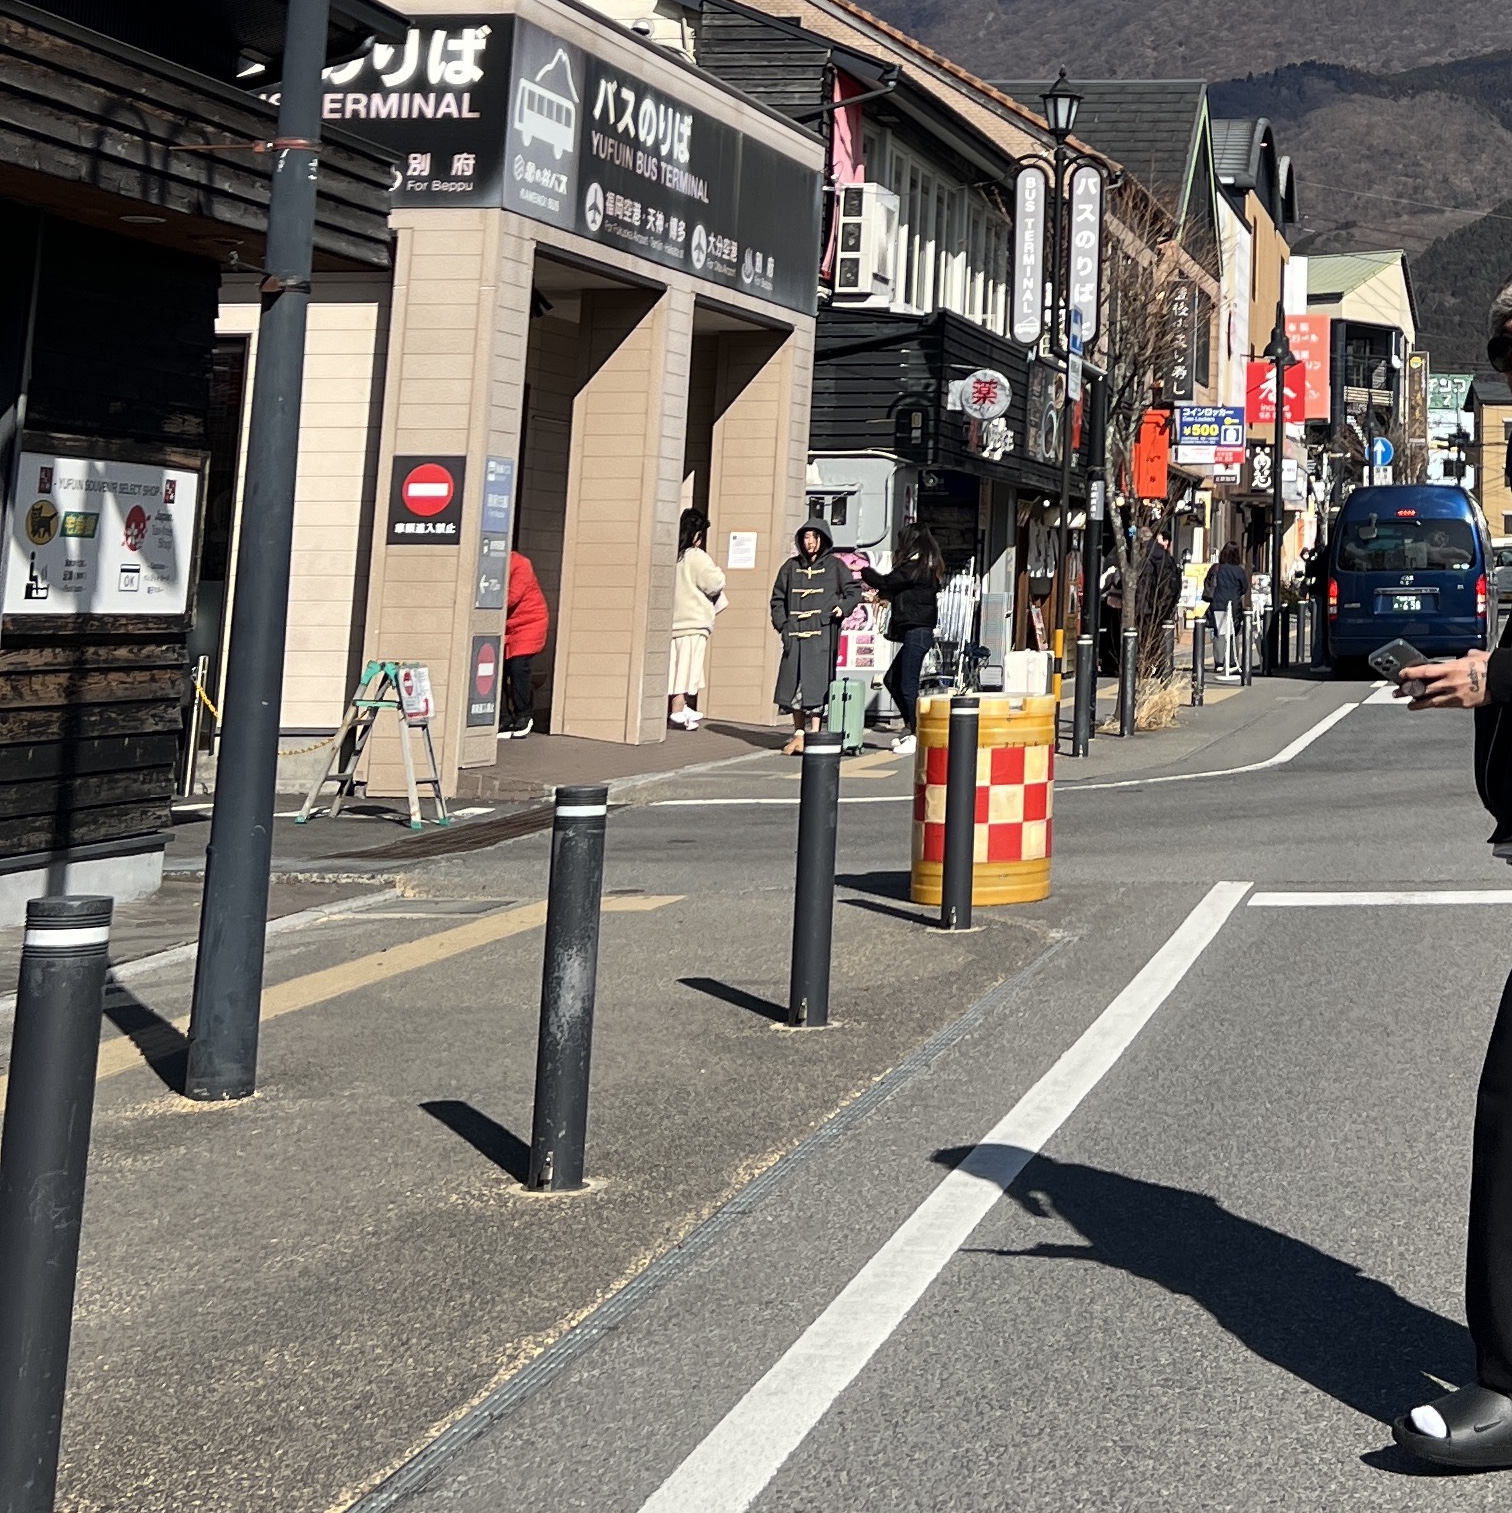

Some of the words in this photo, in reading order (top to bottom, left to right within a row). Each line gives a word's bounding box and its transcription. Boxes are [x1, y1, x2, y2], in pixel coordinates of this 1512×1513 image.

[321, 92, 481, 119] ERMINAL
[592, 78, 693, 164] バスのりば
[590, 130, 634, 171] YUFUIN
[635, 150, 658, 182] BUS
[659, 161, 710, 204] TERMINAL
[406, 179, 428, 191] For
[431, 180, 474, 192] Beppu
[1024, 176, 1036, 212] BUS
[1073, 176, 1098, 304] バスのりば
[1022, 218, 1036, 314] TERMINAL
[1182, 407, 1235, 417] コインロッカー
[1183, 423, 1220, 437] ¥500
